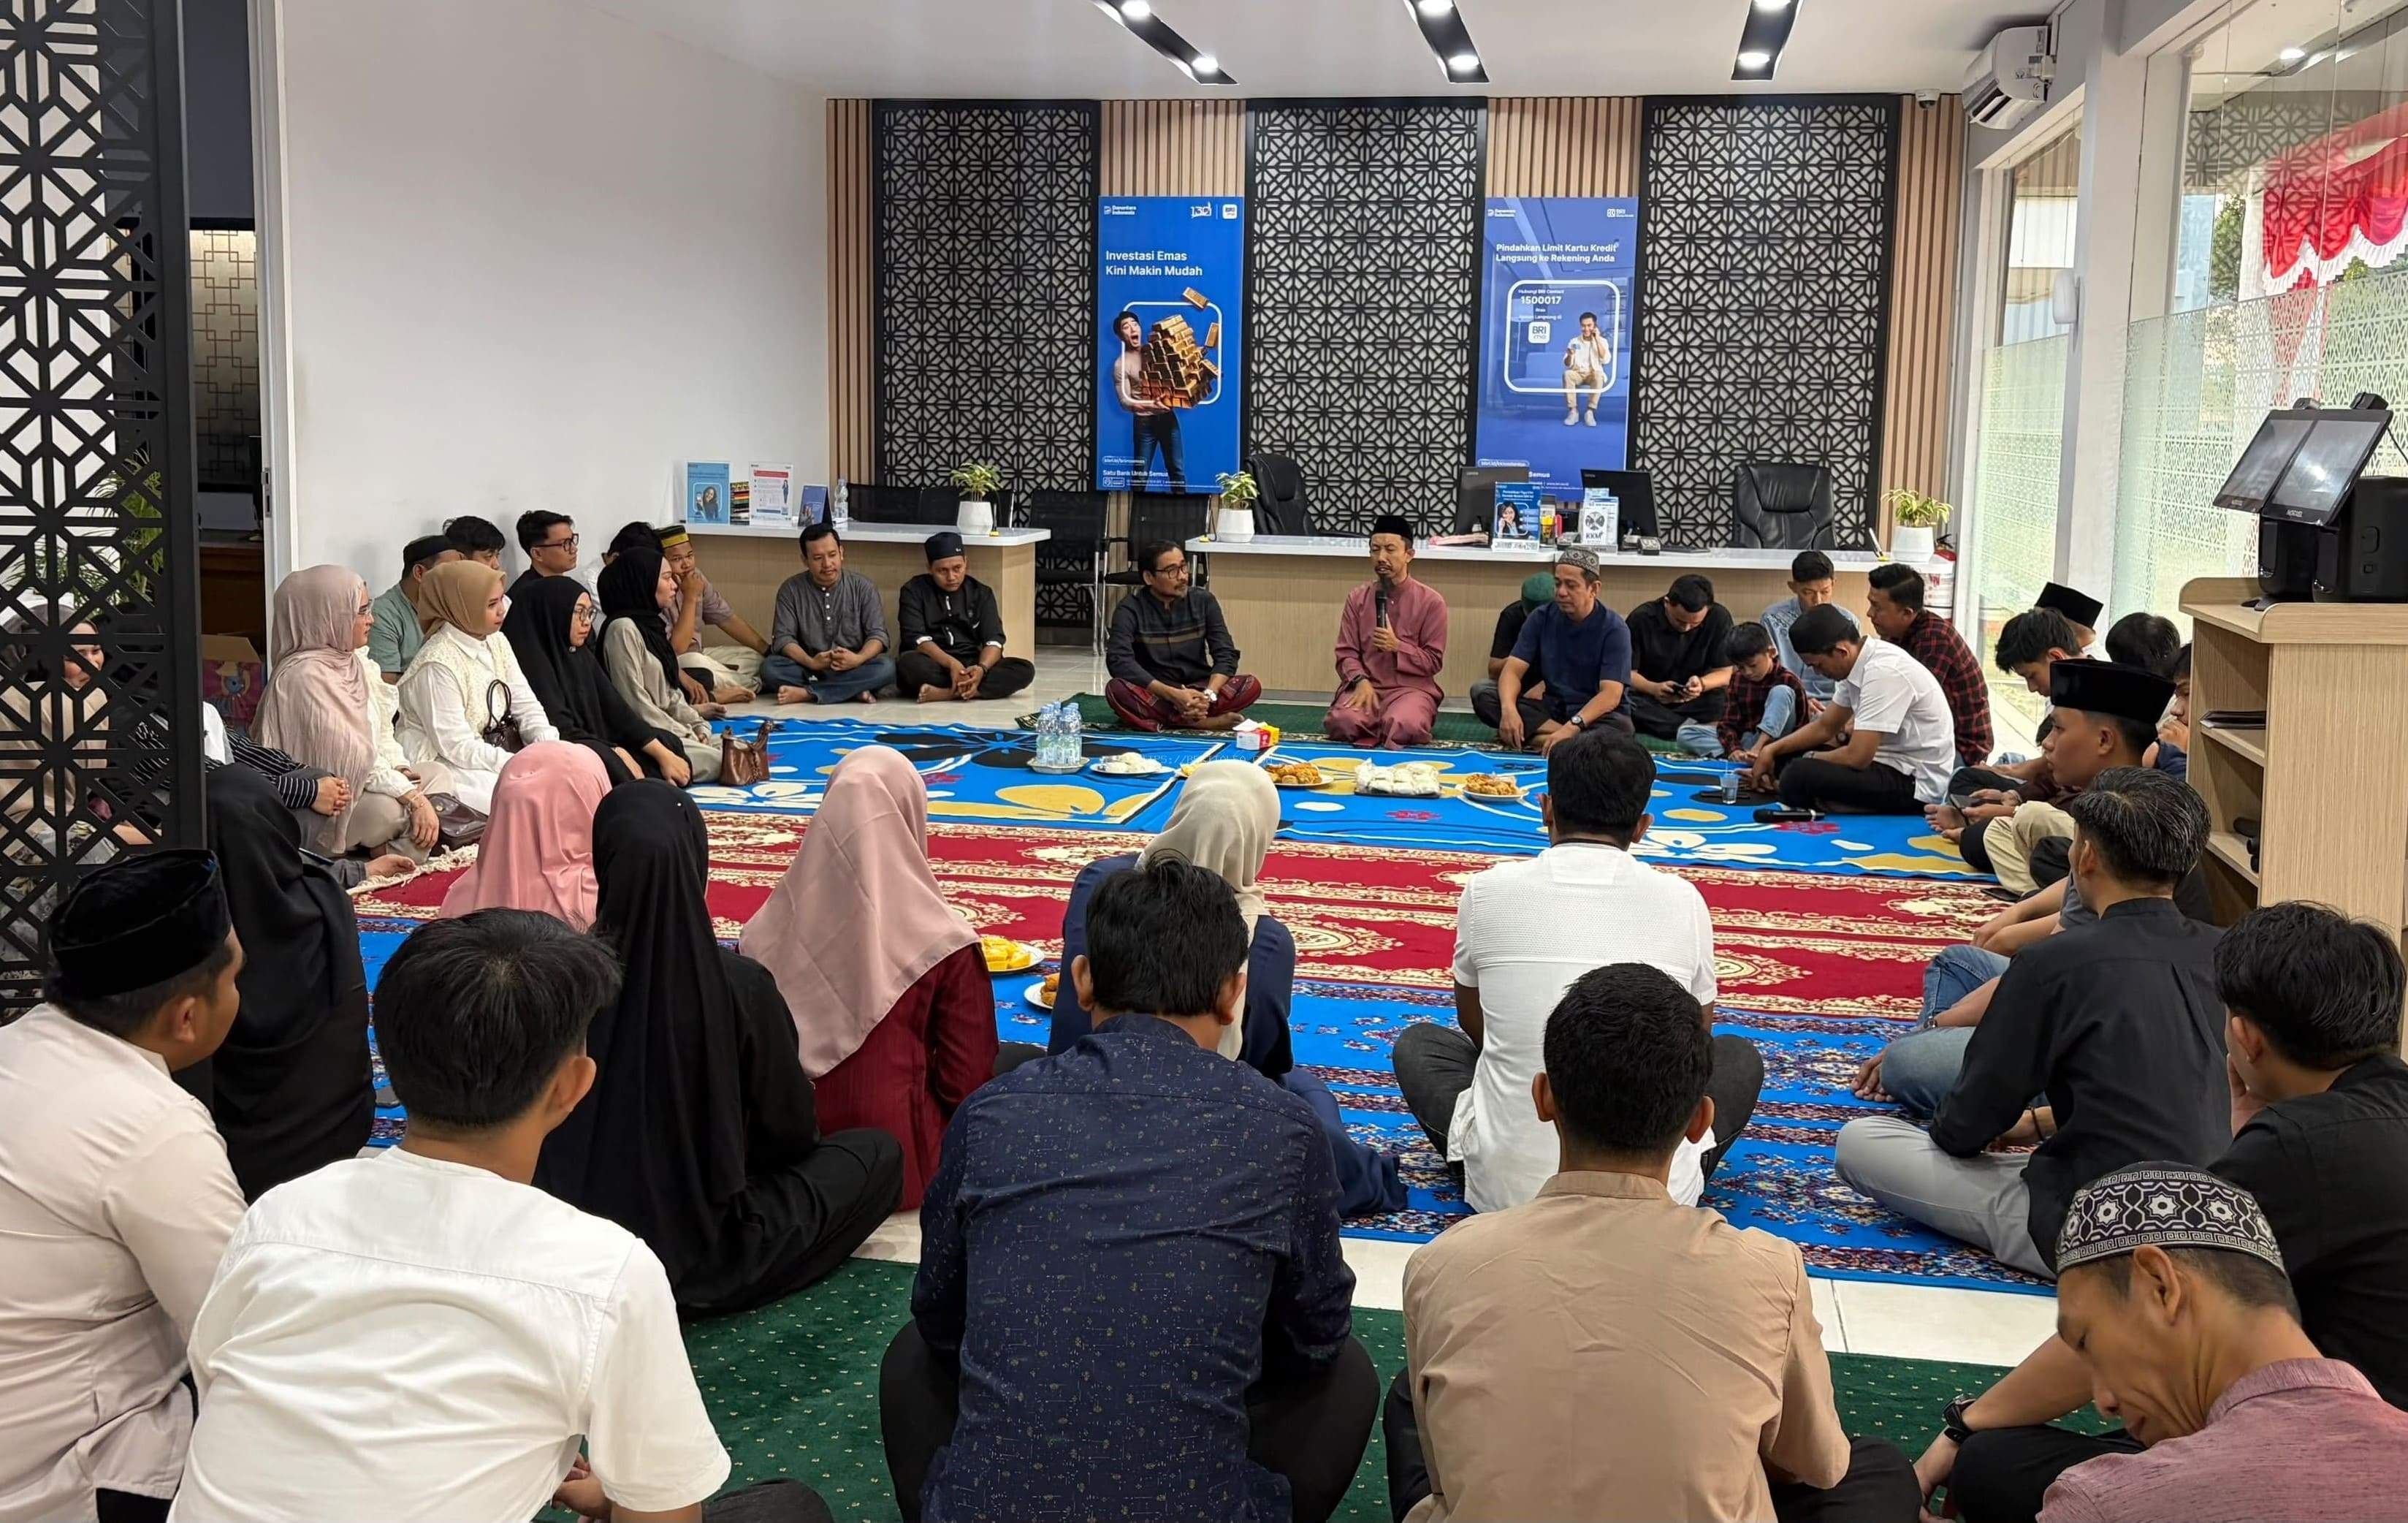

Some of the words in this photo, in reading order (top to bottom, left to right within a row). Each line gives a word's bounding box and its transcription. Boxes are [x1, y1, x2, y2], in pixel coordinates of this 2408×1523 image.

[1496, 243, 1541, 252] Pindahkan
[1542, 243, 1563, 252] Limit
[1565, 243, 1589, 252] Kartu
[1105, 250, 1154, 261] Investasi
[1157, 251, 1188, 261] Emas
[1496, 254, 1537, 264] Langsung
[1539, 254, 1550, 262] ke
[1551, 254, 1590, 264] Rekening
[1592, 254, 1615, 263] Anda
[1105, 265, 1127, 276] Kini
[1129, 265, 1162, 276] Makin
[1165, 265, 1203, 276] Mudah
[1520, 296, 1562, 305] 1500017
[1532, 326, 1547, 334] BRI
